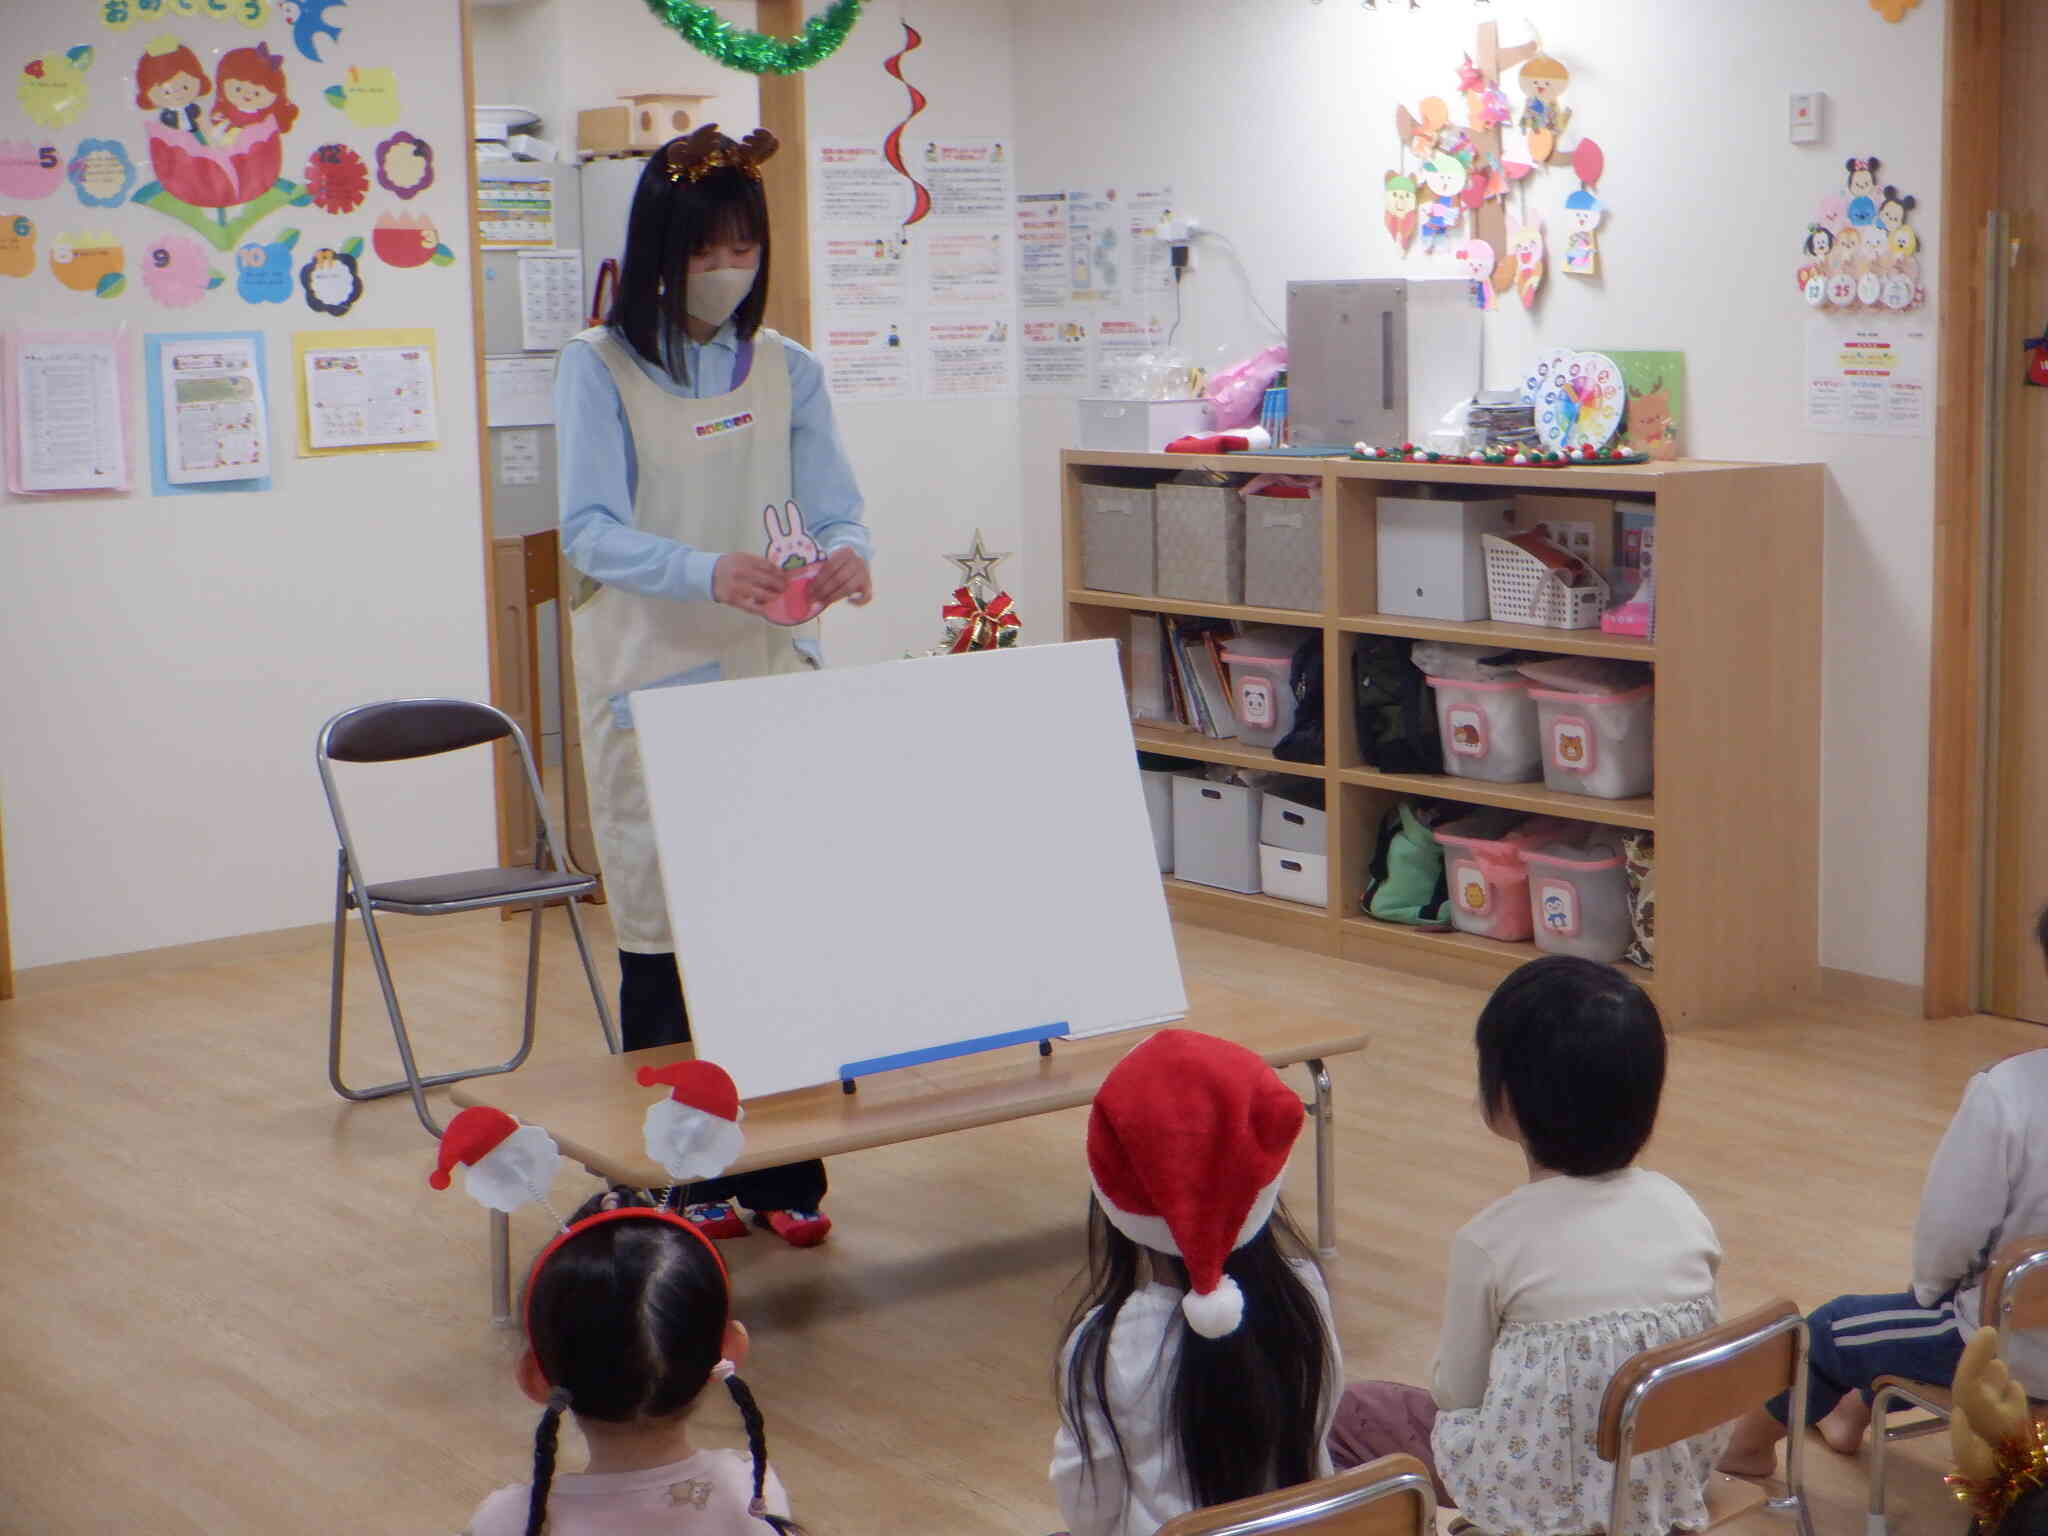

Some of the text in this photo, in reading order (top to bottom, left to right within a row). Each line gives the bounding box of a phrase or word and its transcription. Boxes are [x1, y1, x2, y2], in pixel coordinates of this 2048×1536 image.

[25, 60, 45, 79] 4
[39, 147, 58, 168] 5
[13, 216, 31, 237] 6
[152, 248, 171, 268] 9
[239, 247, 267, 268] 10
